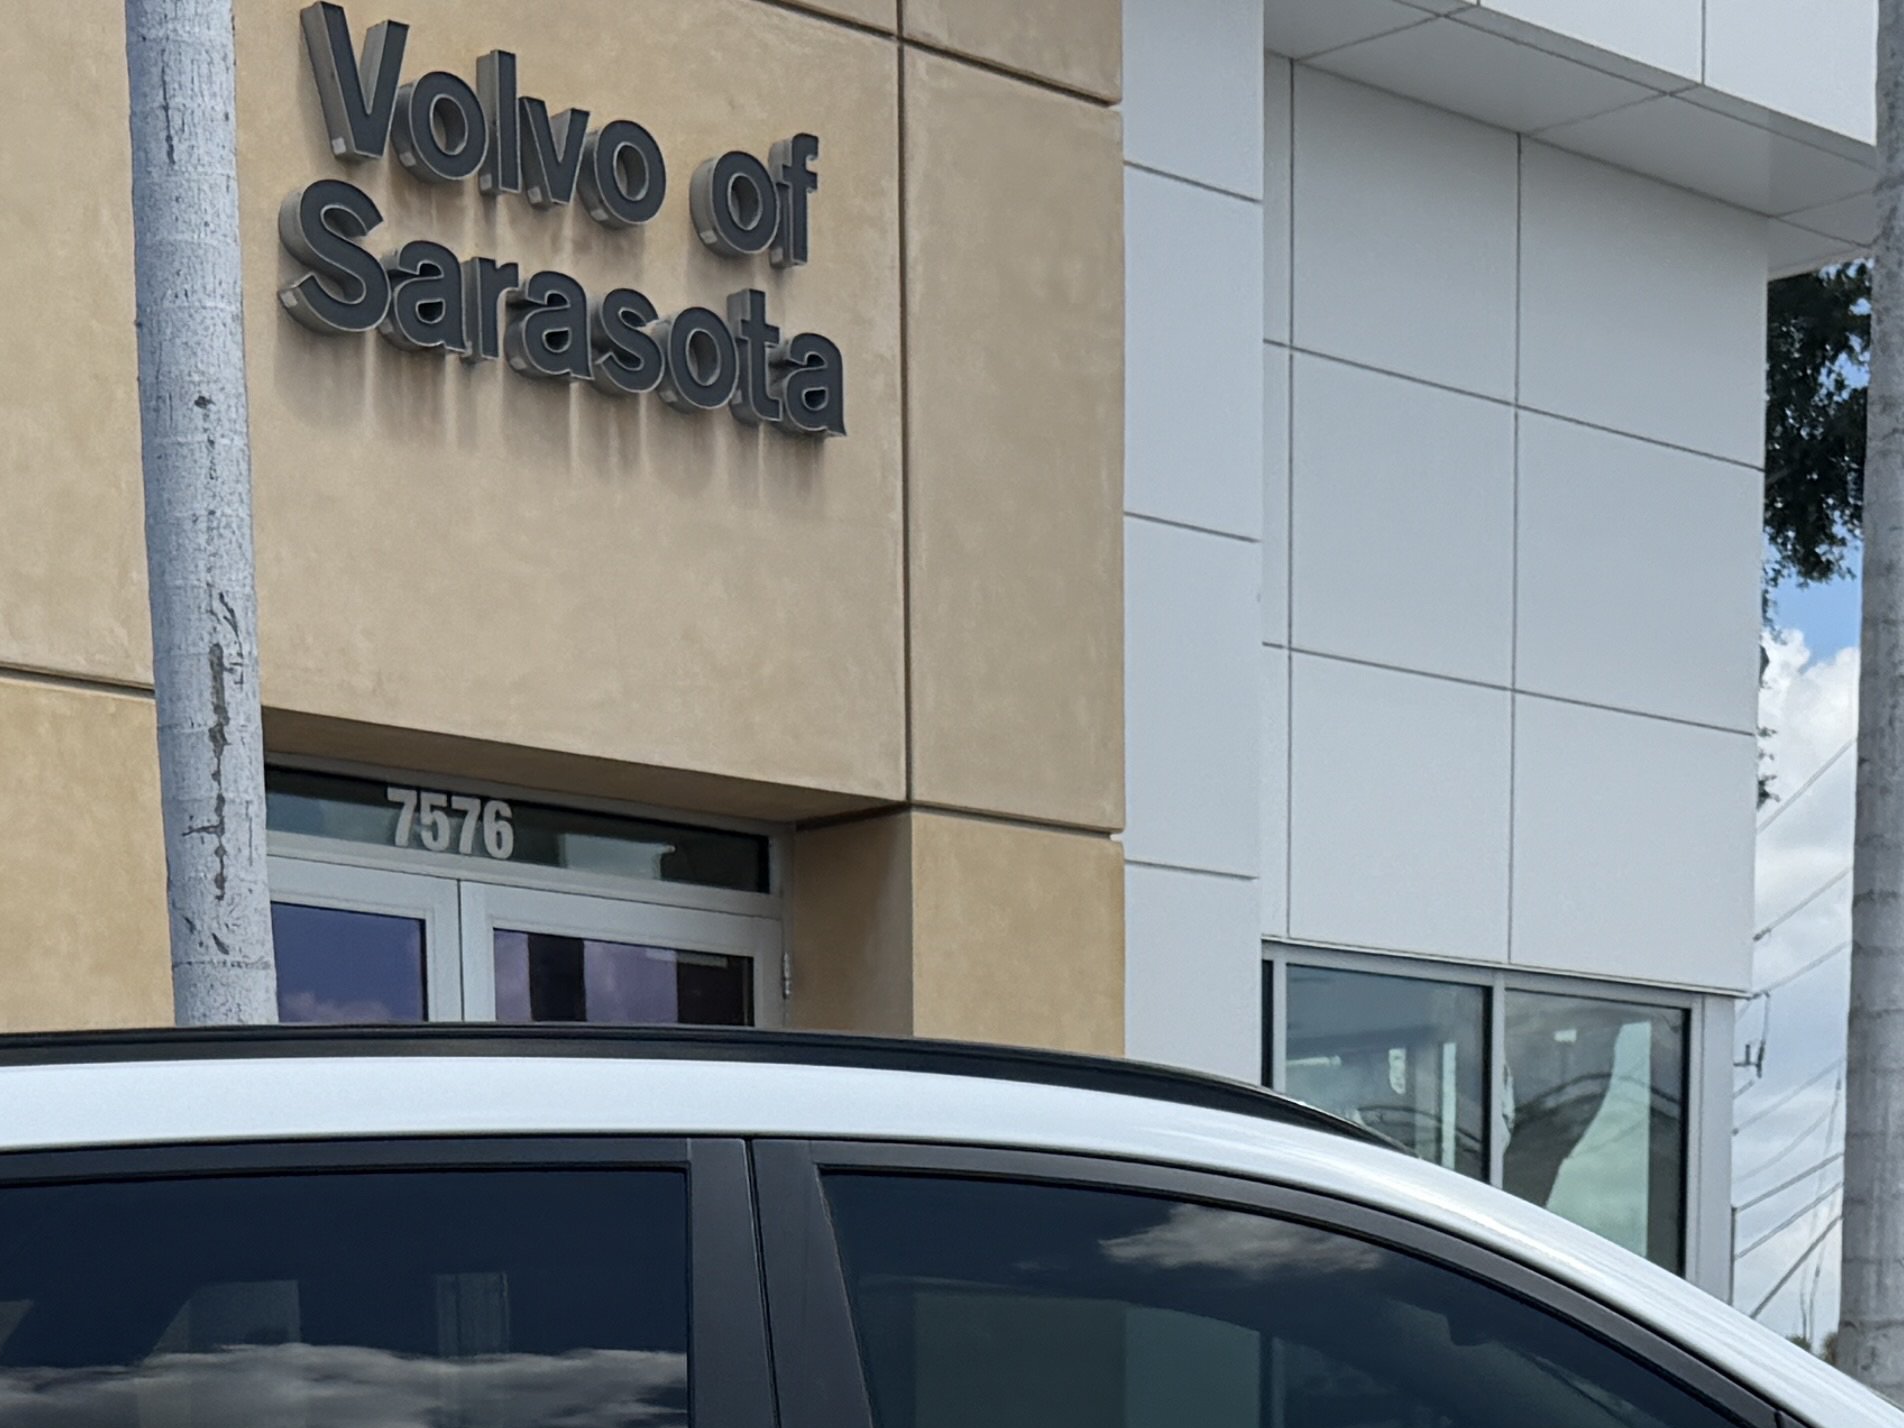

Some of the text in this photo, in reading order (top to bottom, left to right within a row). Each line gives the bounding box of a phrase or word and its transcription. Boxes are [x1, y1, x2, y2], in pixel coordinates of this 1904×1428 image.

[300, 1, 819, 268] Volvo of
[278, 179, 847, 437] Sarasota
[385, 786, 515, 860] 7576
